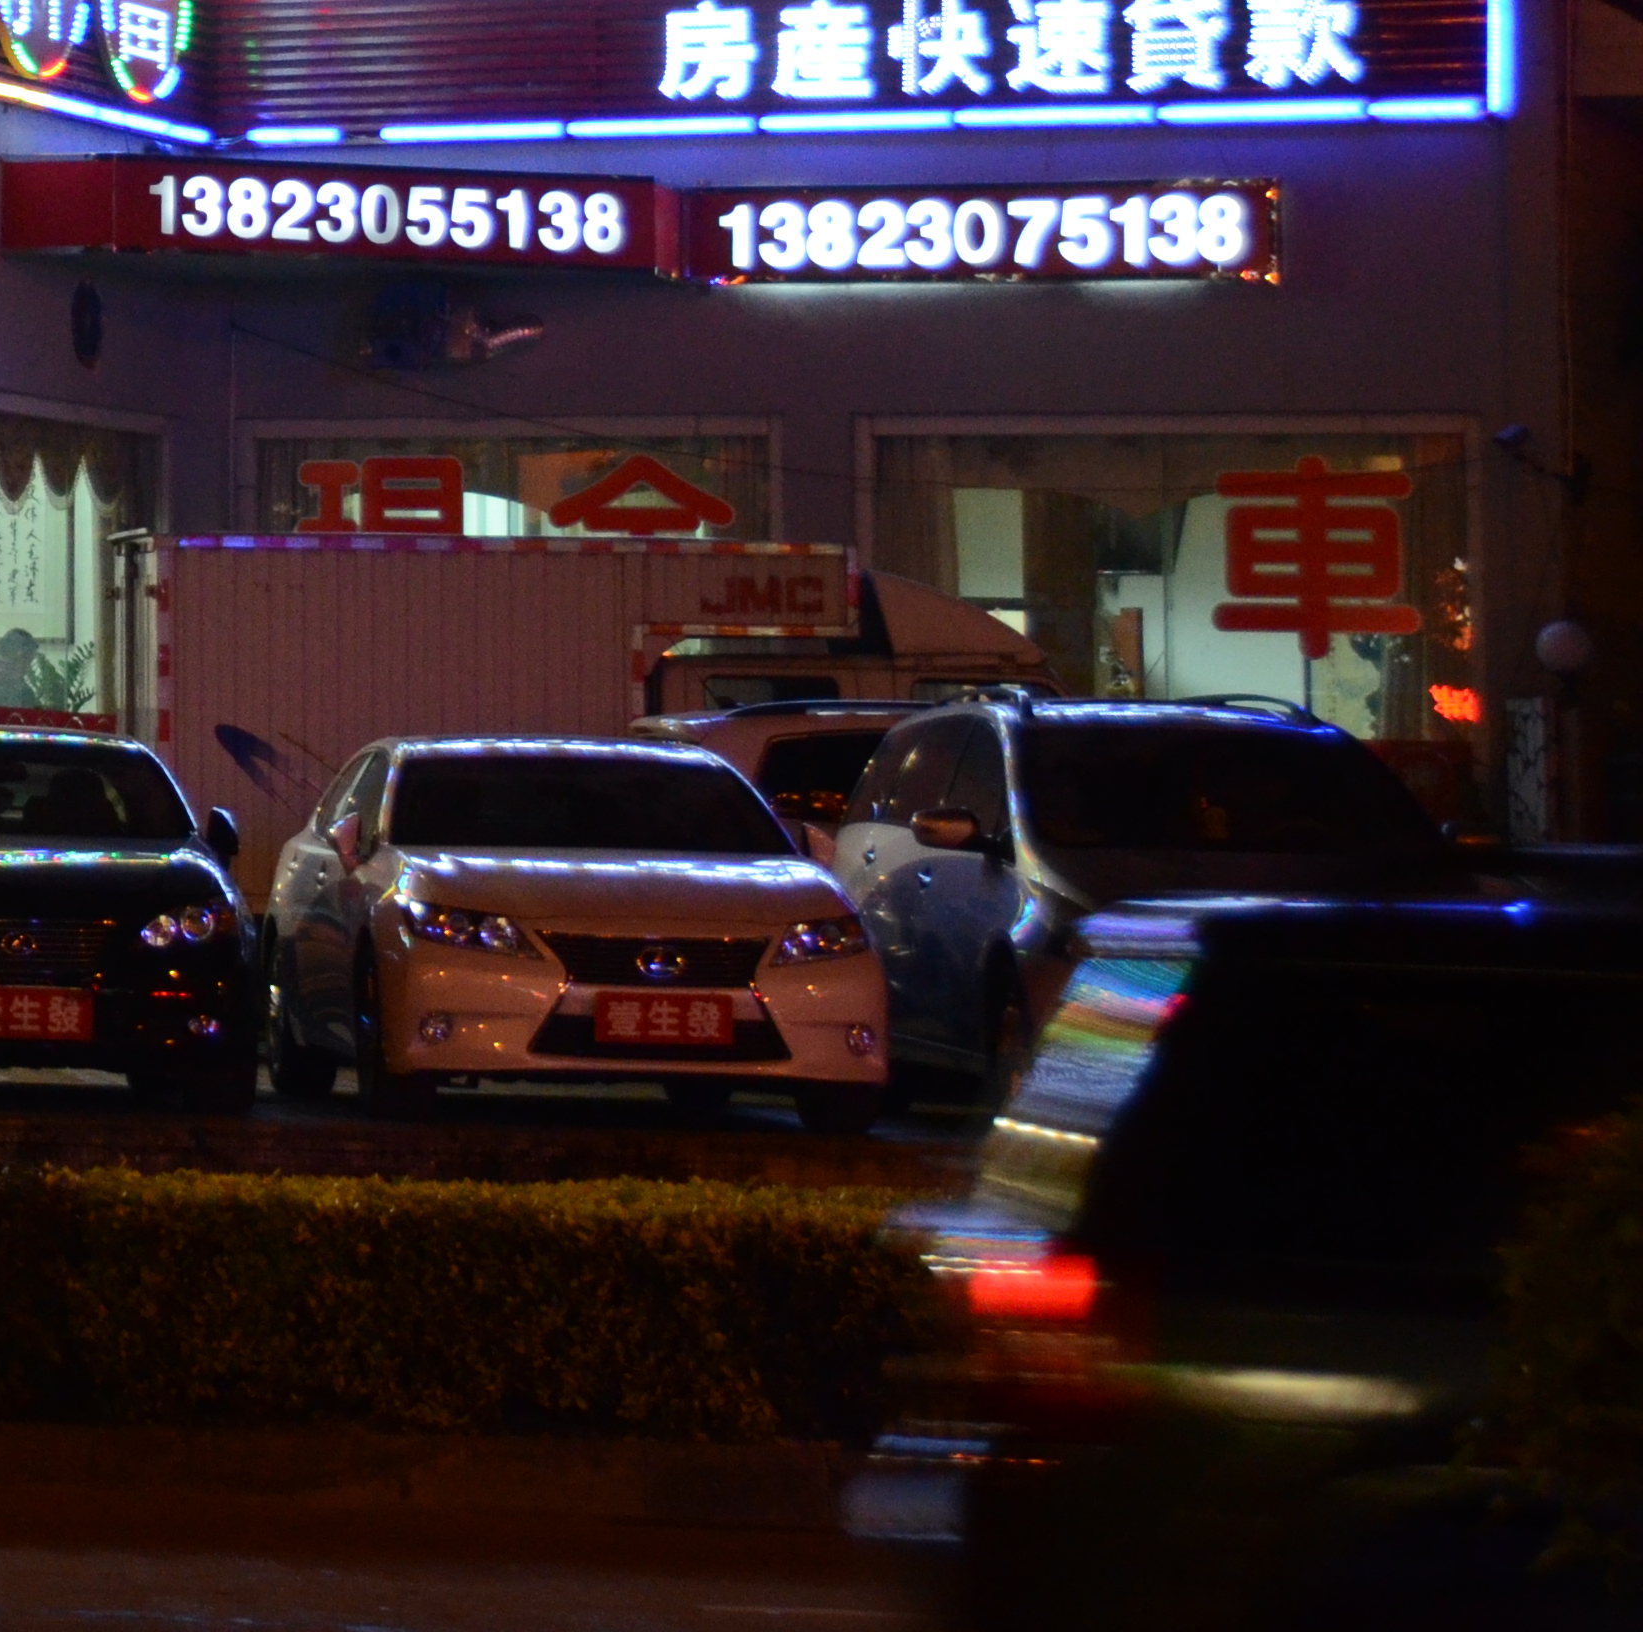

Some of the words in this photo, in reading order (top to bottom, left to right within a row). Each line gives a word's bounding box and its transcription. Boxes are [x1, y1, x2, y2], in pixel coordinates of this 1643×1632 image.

[148, 173, 624, 255] 13823055138
[717, 192, 1247, 270] 13823075138
[699, 575, 825, 615] JMC
[1212, 454, 1423, 659] 車
[606, 999, 722, 1039] 壹生發
